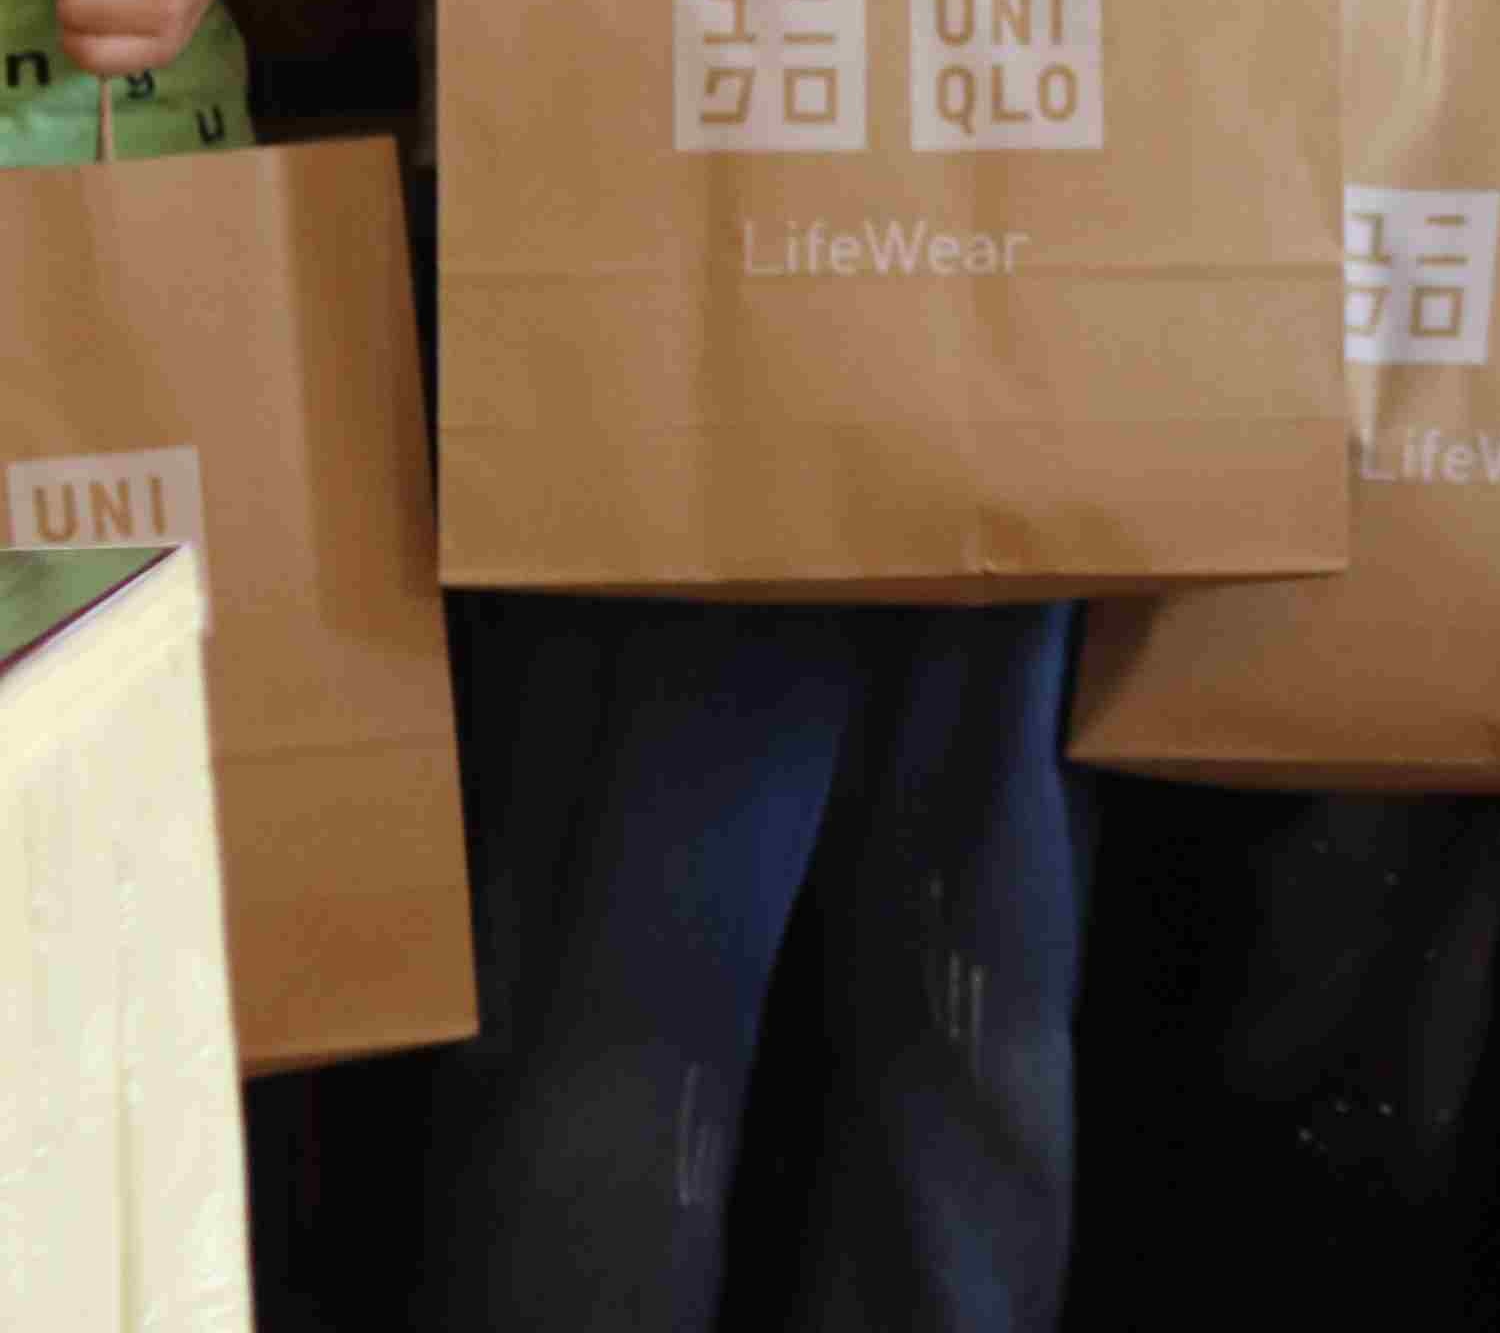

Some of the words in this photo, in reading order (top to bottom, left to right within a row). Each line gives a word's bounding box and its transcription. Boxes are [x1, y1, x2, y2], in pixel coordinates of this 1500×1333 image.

[700, 67, 838, 125] クロ
[935, 65, 1078, 135] QLO
[743, 220, 1030, 278] LifeWear
[32, 475, 166, 544] UNI
